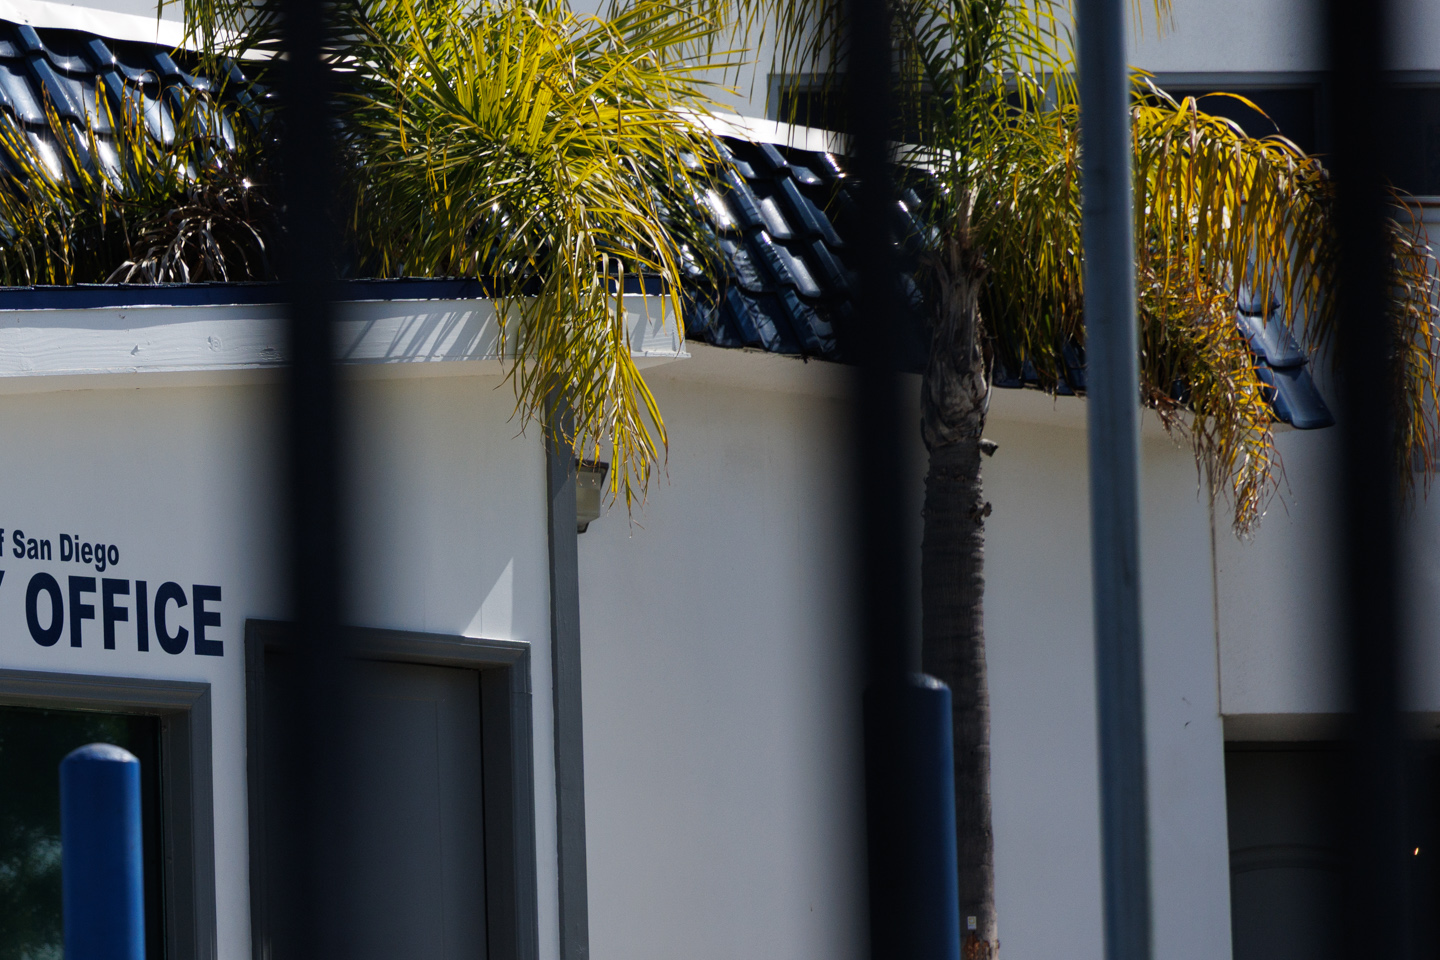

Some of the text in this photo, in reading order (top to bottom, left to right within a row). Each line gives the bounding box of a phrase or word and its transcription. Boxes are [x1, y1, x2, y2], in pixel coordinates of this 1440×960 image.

[11, 529, 52, 561] San
[59, 533, 120, 573] Diego
[24, 571, 225, 657] OFFICE
